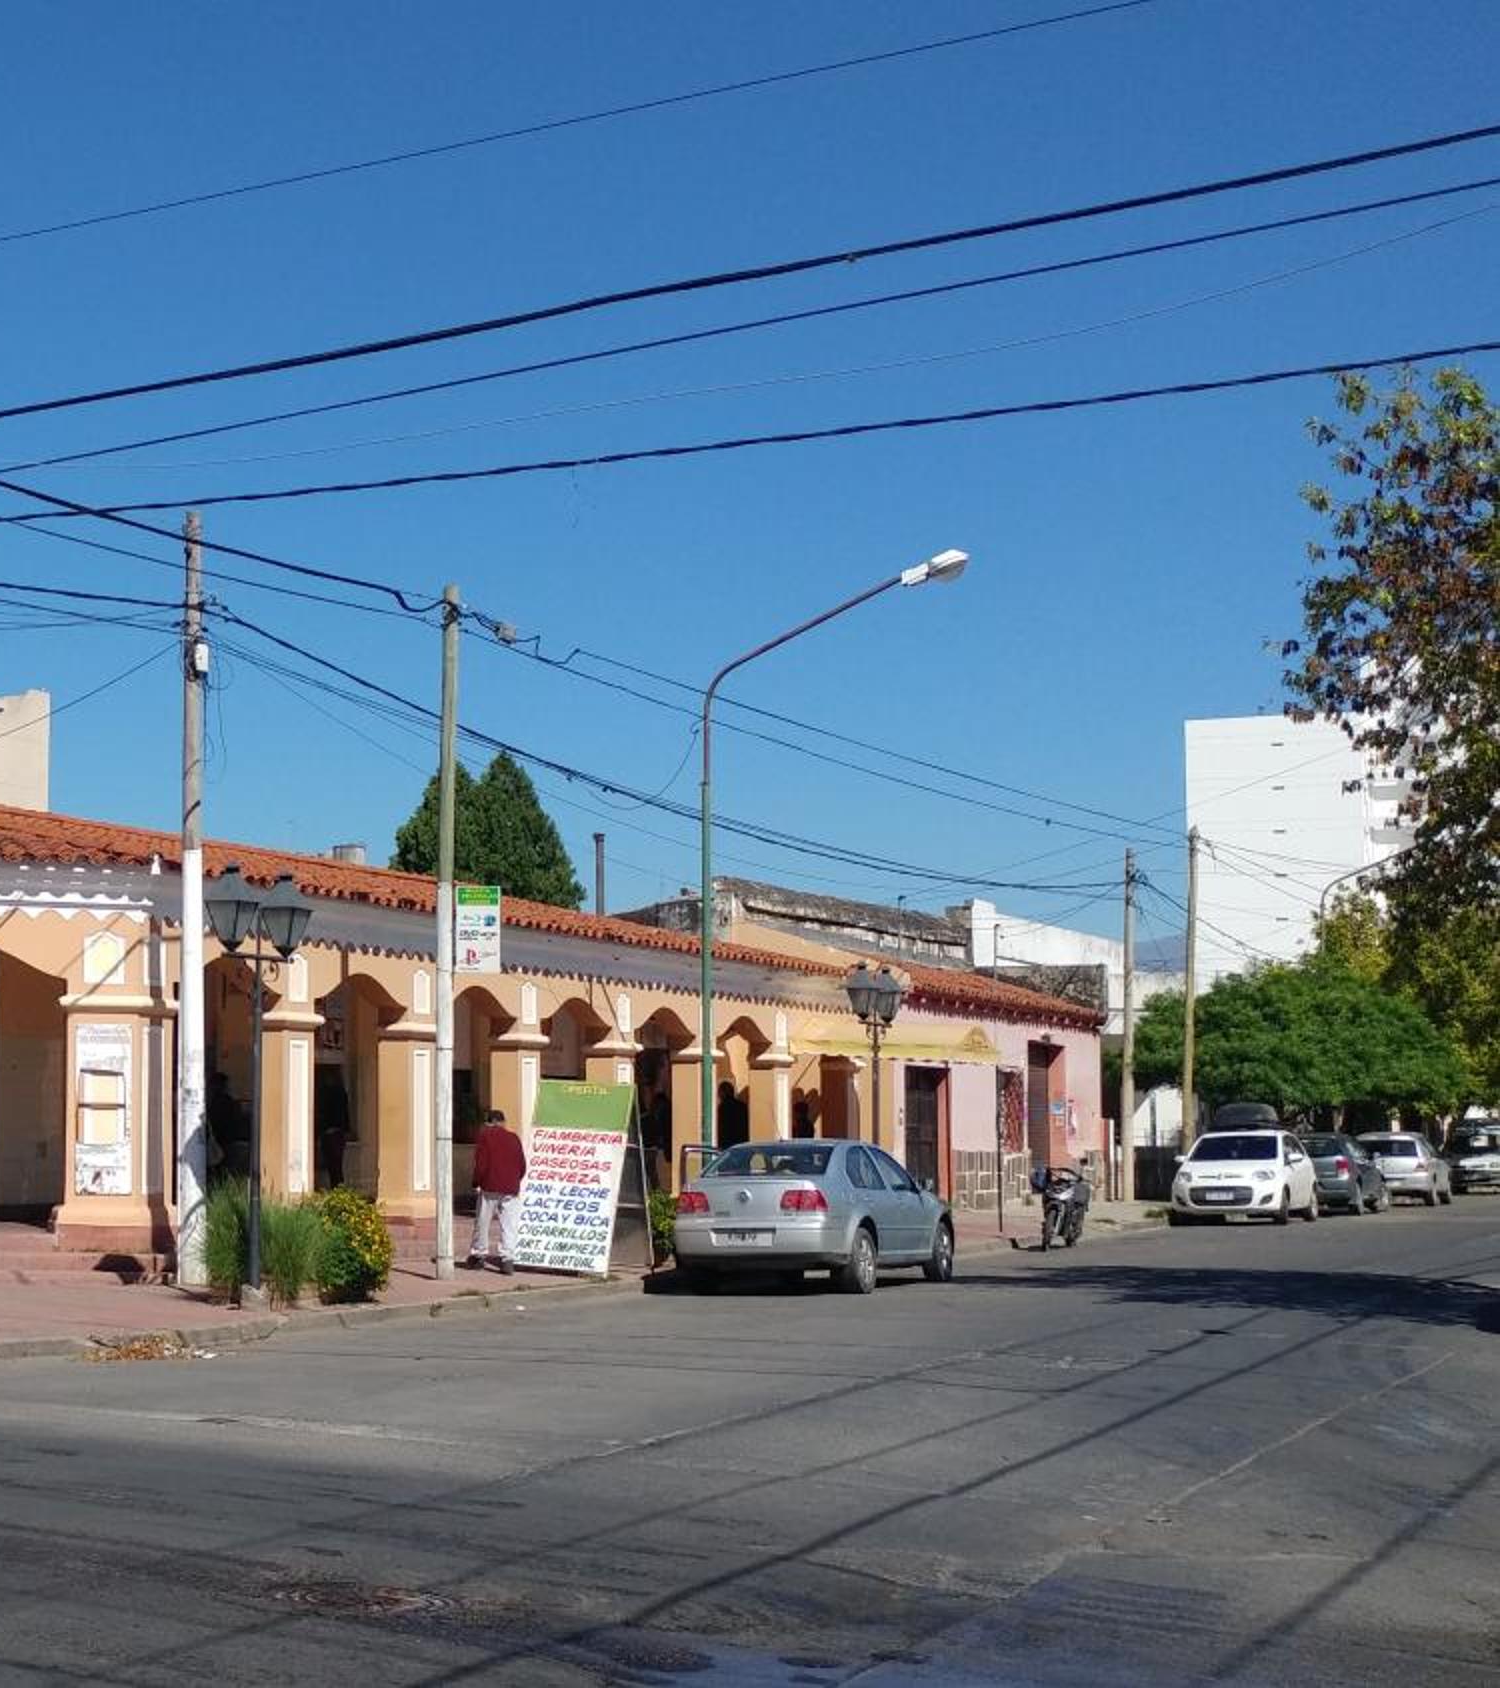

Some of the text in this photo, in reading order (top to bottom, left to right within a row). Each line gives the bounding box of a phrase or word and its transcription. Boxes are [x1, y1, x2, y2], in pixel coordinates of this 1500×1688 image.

[533, 1129, 623, 1144] FIAMBRERIA
[532, 1143, 597, 1156] VINERIA
[530, 1156, 612, 1171] GASEOSAS
[528, 1170, 601, 1184] CERVEZA
[560, 1185, 610, 1199] LECHE
[523, 1197, 601, 1213] LACTEOS
[573, 1214, 610, 1228] BICA
[517, 1224, 609, 1242] CIGARRILLOS
[544, 1241, 607, 1256] LIMPIEZA
[548, 1254, 595, 1268] VIRTUAL
